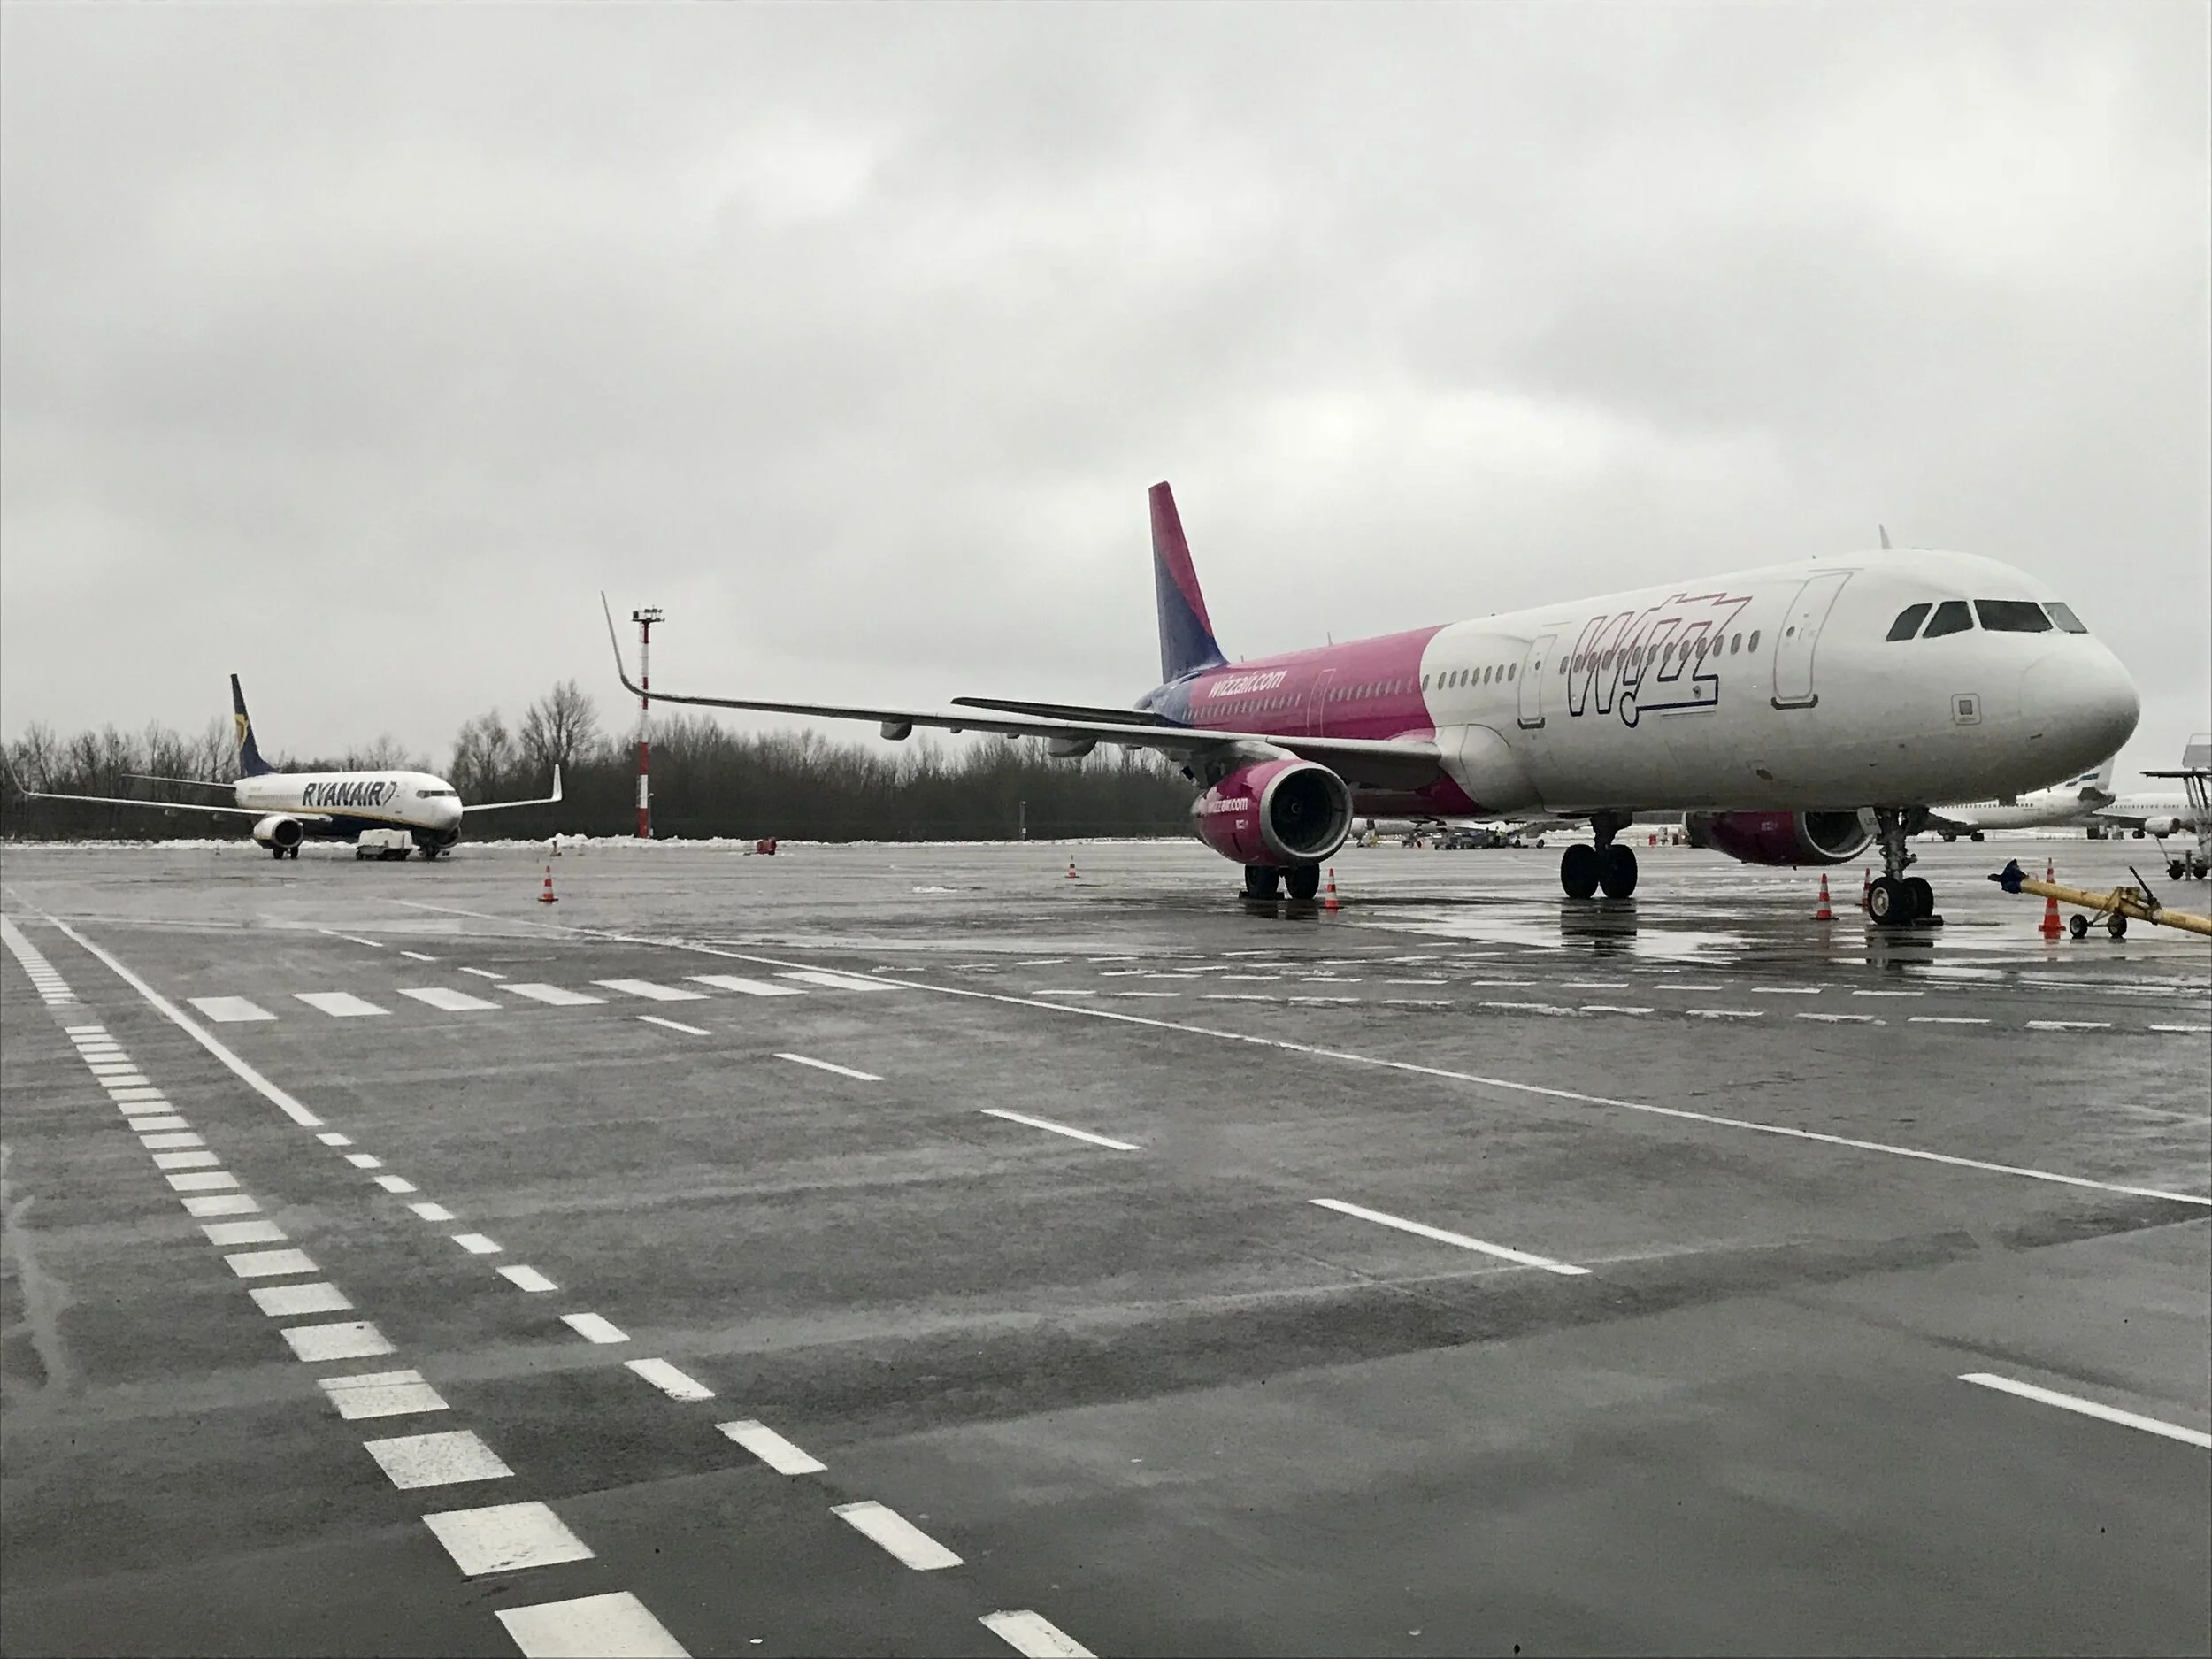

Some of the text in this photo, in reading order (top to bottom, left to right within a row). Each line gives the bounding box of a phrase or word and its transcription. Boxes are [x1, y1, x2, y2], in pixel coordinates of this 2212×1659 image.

[1568, 592, 1753, 728] Wizz
[1208, 670, 1287, 698] wizzair.com
[302, 781, 386, 806] RYANAIR
[1206, 796, 1248, 813] zzair.com
